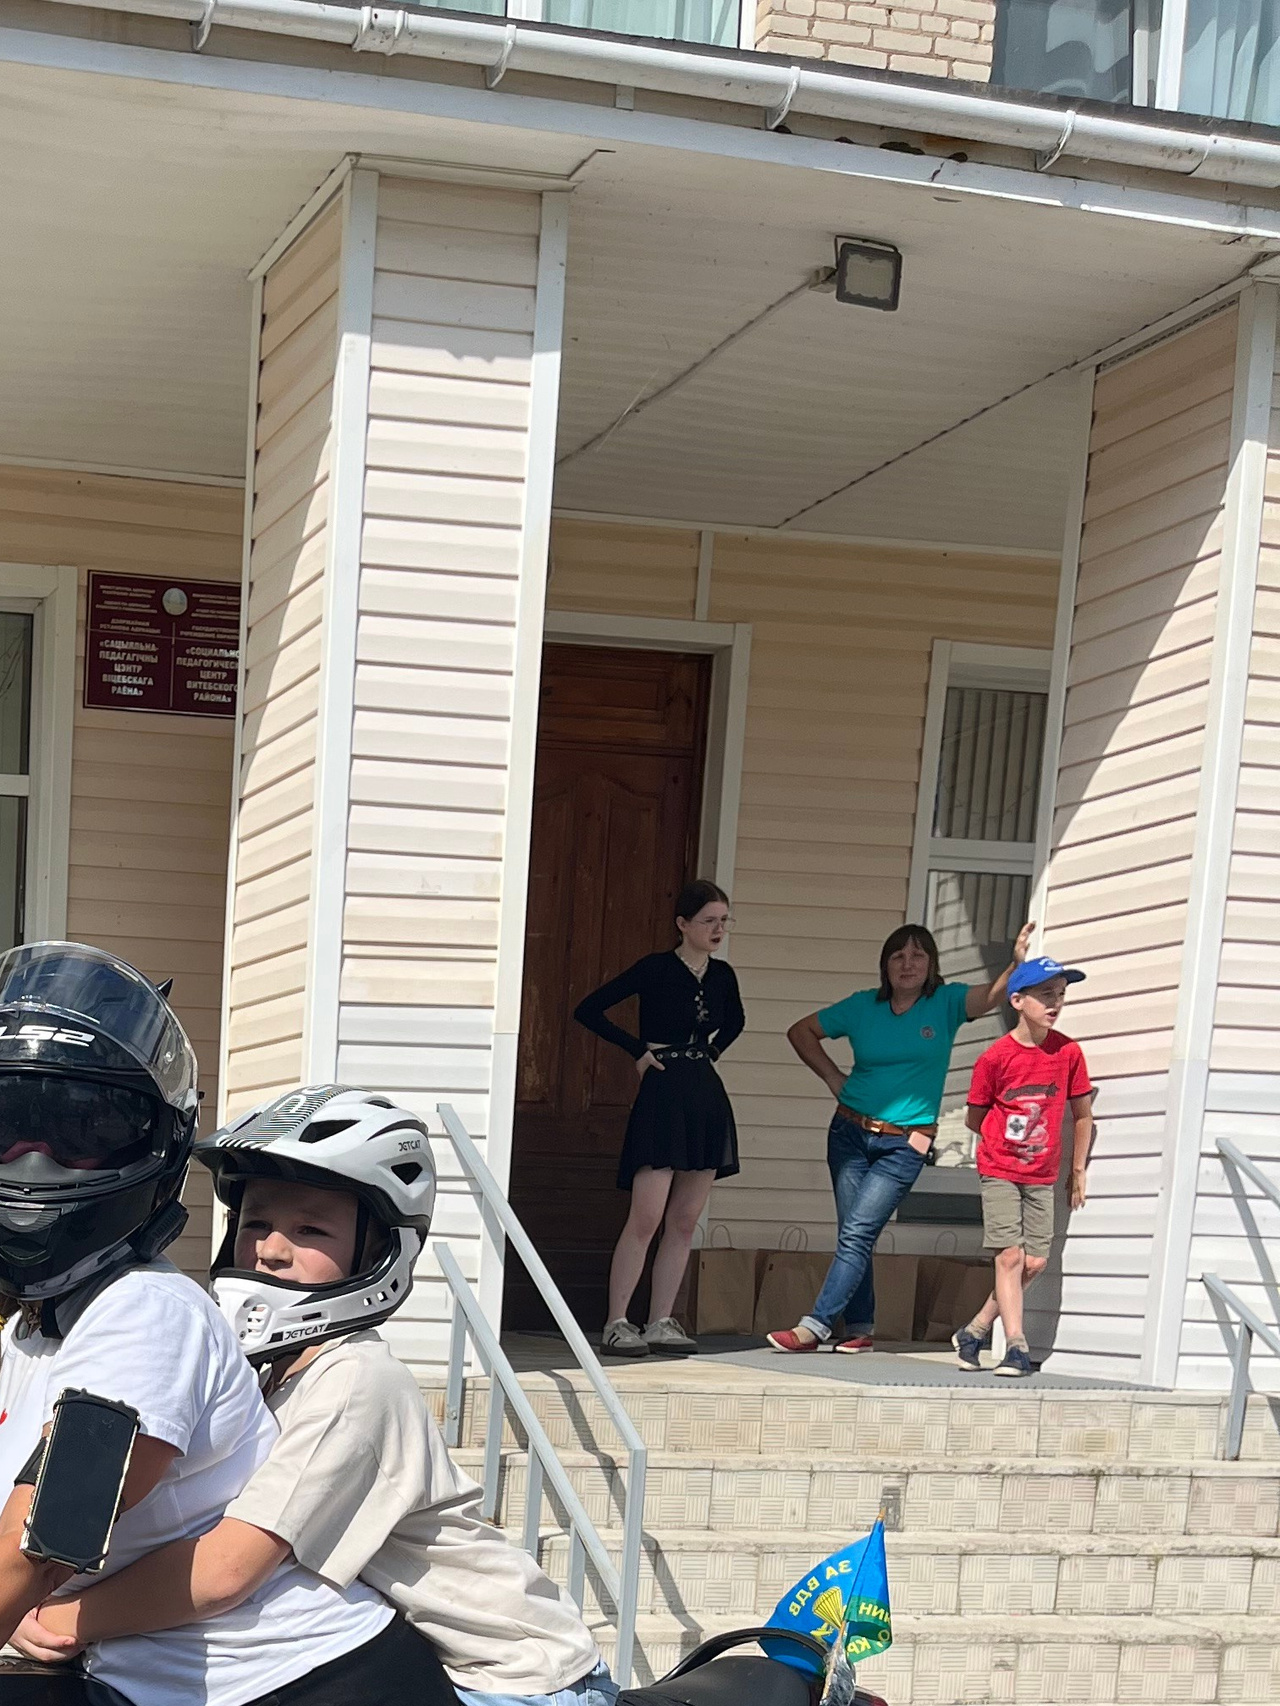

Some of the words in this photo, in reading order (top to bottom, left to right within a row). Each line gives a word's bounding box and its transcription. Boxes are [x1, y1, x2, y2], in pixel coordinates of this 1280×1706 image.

[99, 650, 158, 663] ПЕДАГАГІЧНЫ
[114, 663, 143, 674] ЦЭНТР
[102, 673, 154, 686] ВІЦЕБСКАГА
[200, 670, 228, 680] ЦЕНТР
[111, 685, 144, 696] РАЁНА»
[193, 692, 232, 703] РАЙОНА»
[397, 1139, 421, 1152] JETCAT
[284, 1323, 327, 1341] JETCAT
